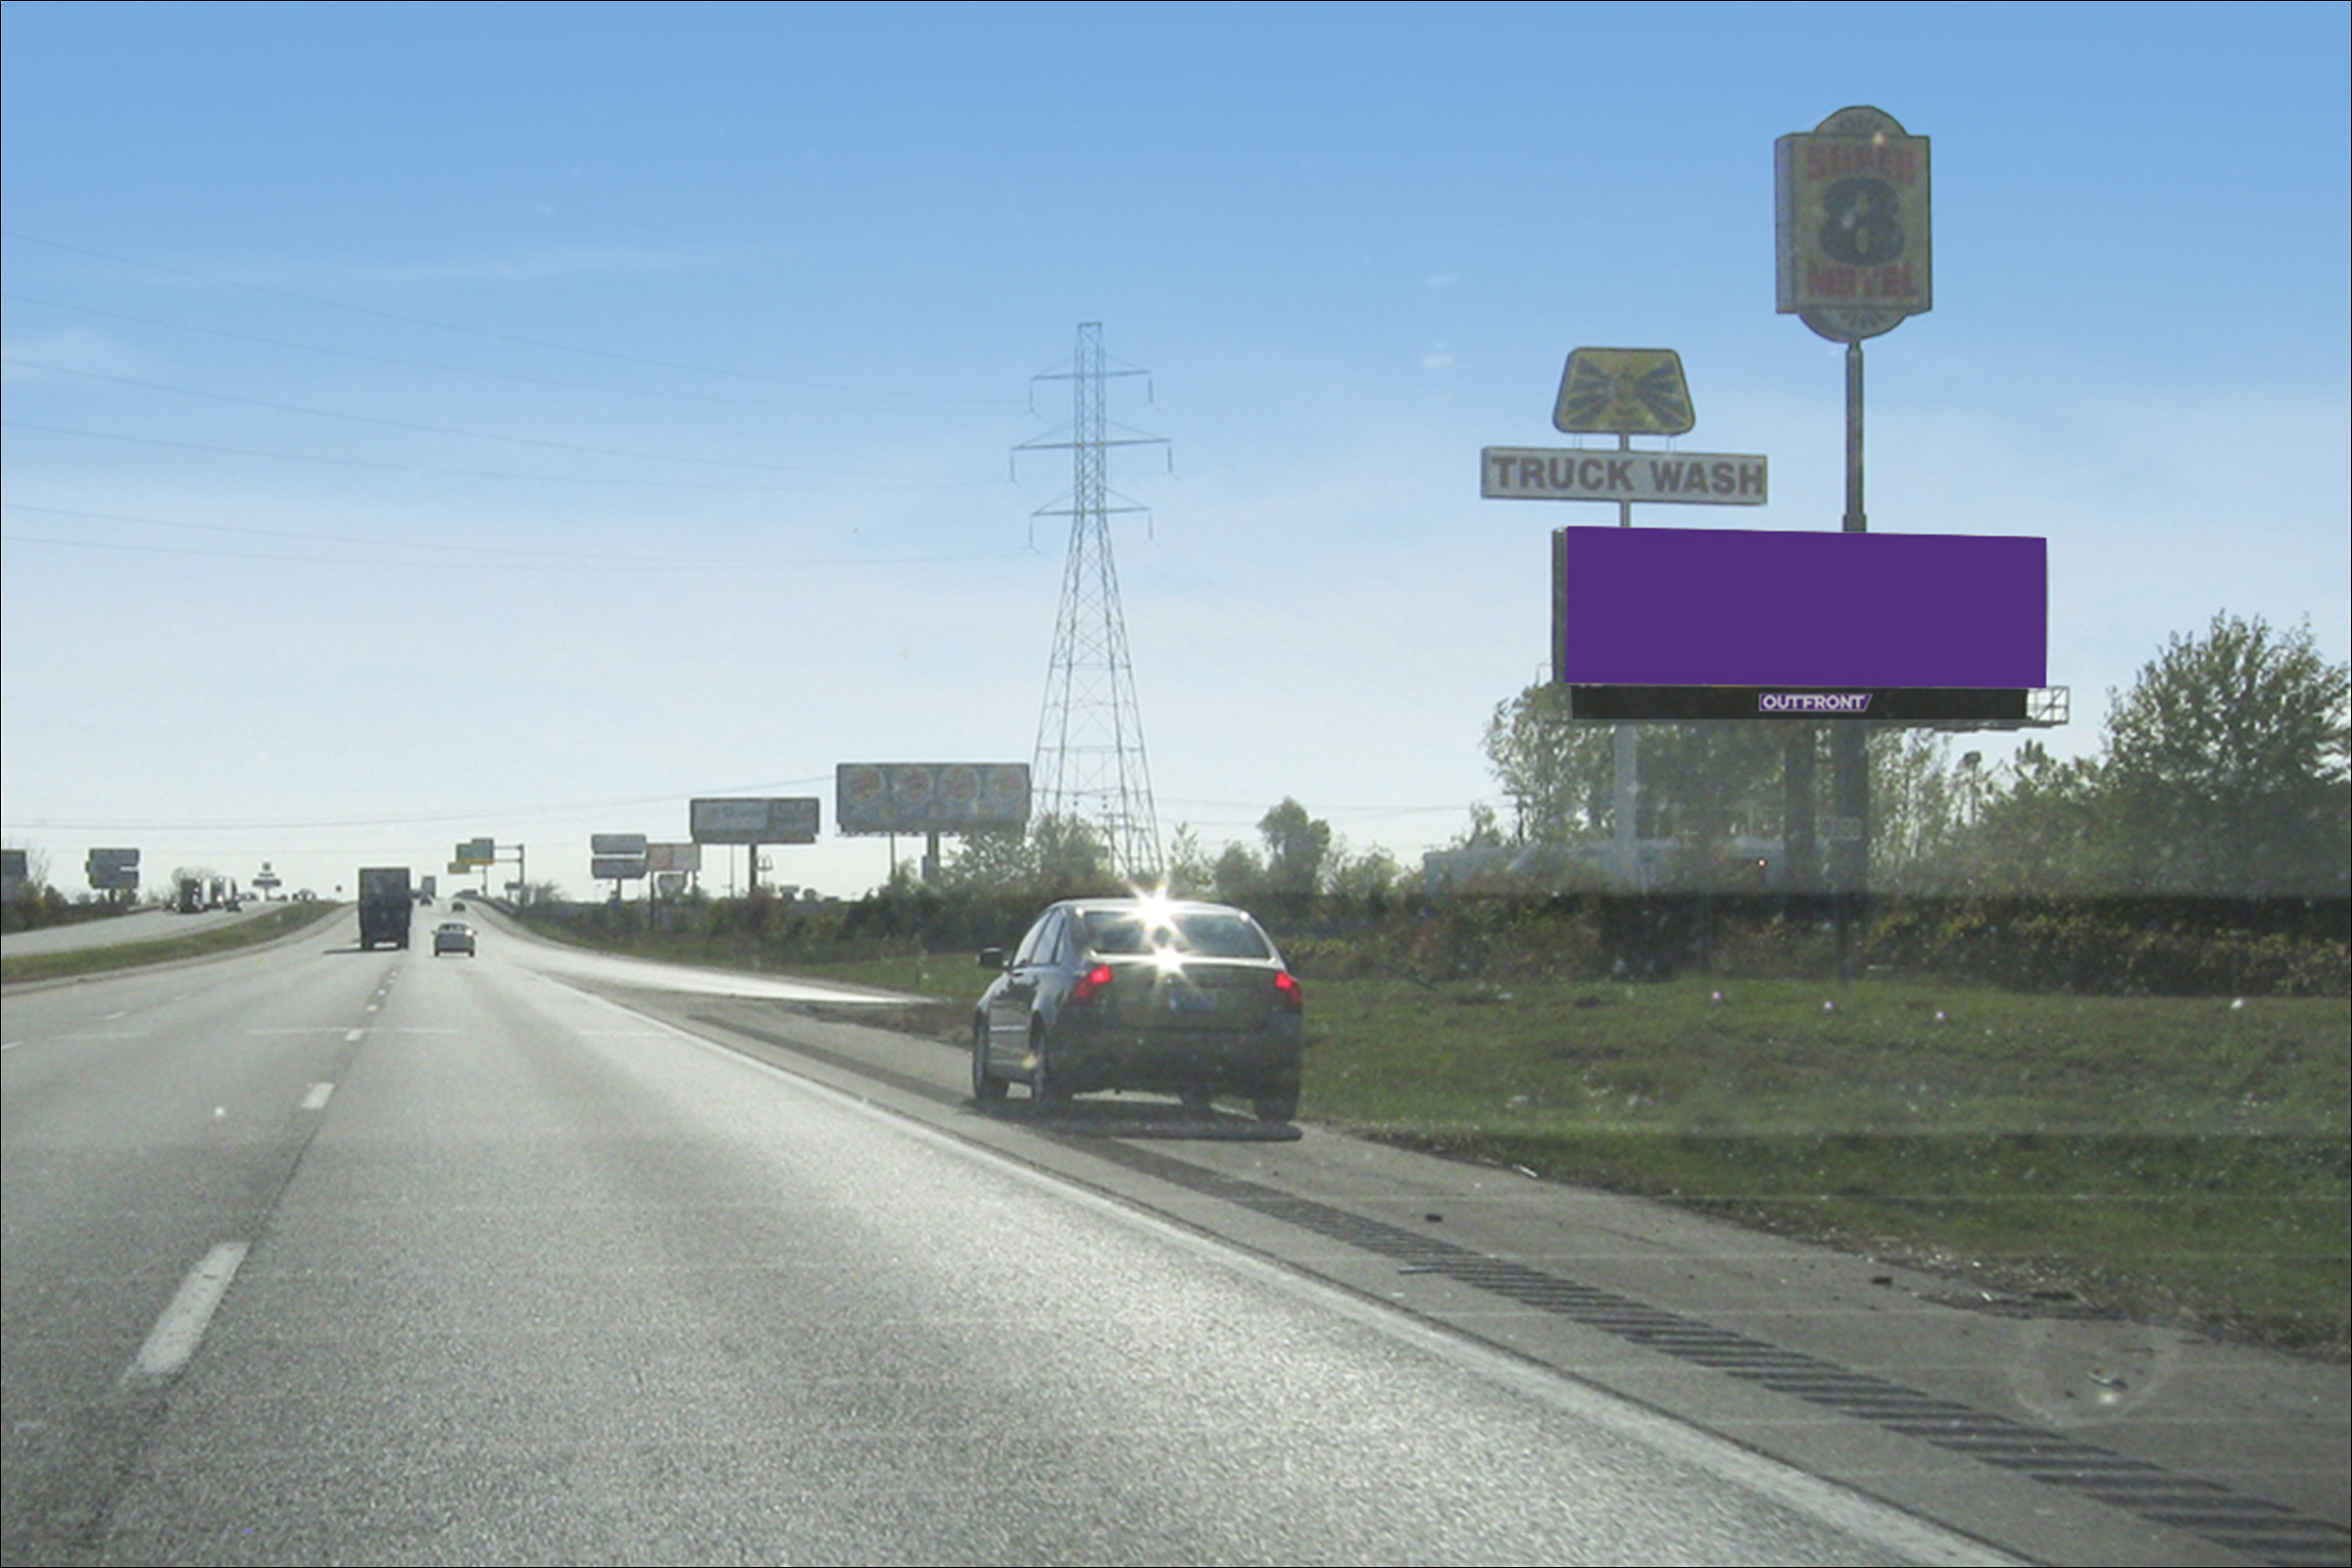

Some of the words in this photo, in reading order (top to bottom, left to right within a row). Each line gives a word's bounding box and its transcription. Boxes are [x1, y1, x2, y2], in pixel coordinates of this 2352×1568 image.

[1805, 144, 1916, 185] SUPER
[1819, 177, 1906, 265] 8
[1806, 261, 1917, 297] MOTEL
[1492, 458, 1634, 490] TRUCK
[1650, 461, 1763, 495] WASH
[1763, 694, 1866, 710] OUTFRONT
